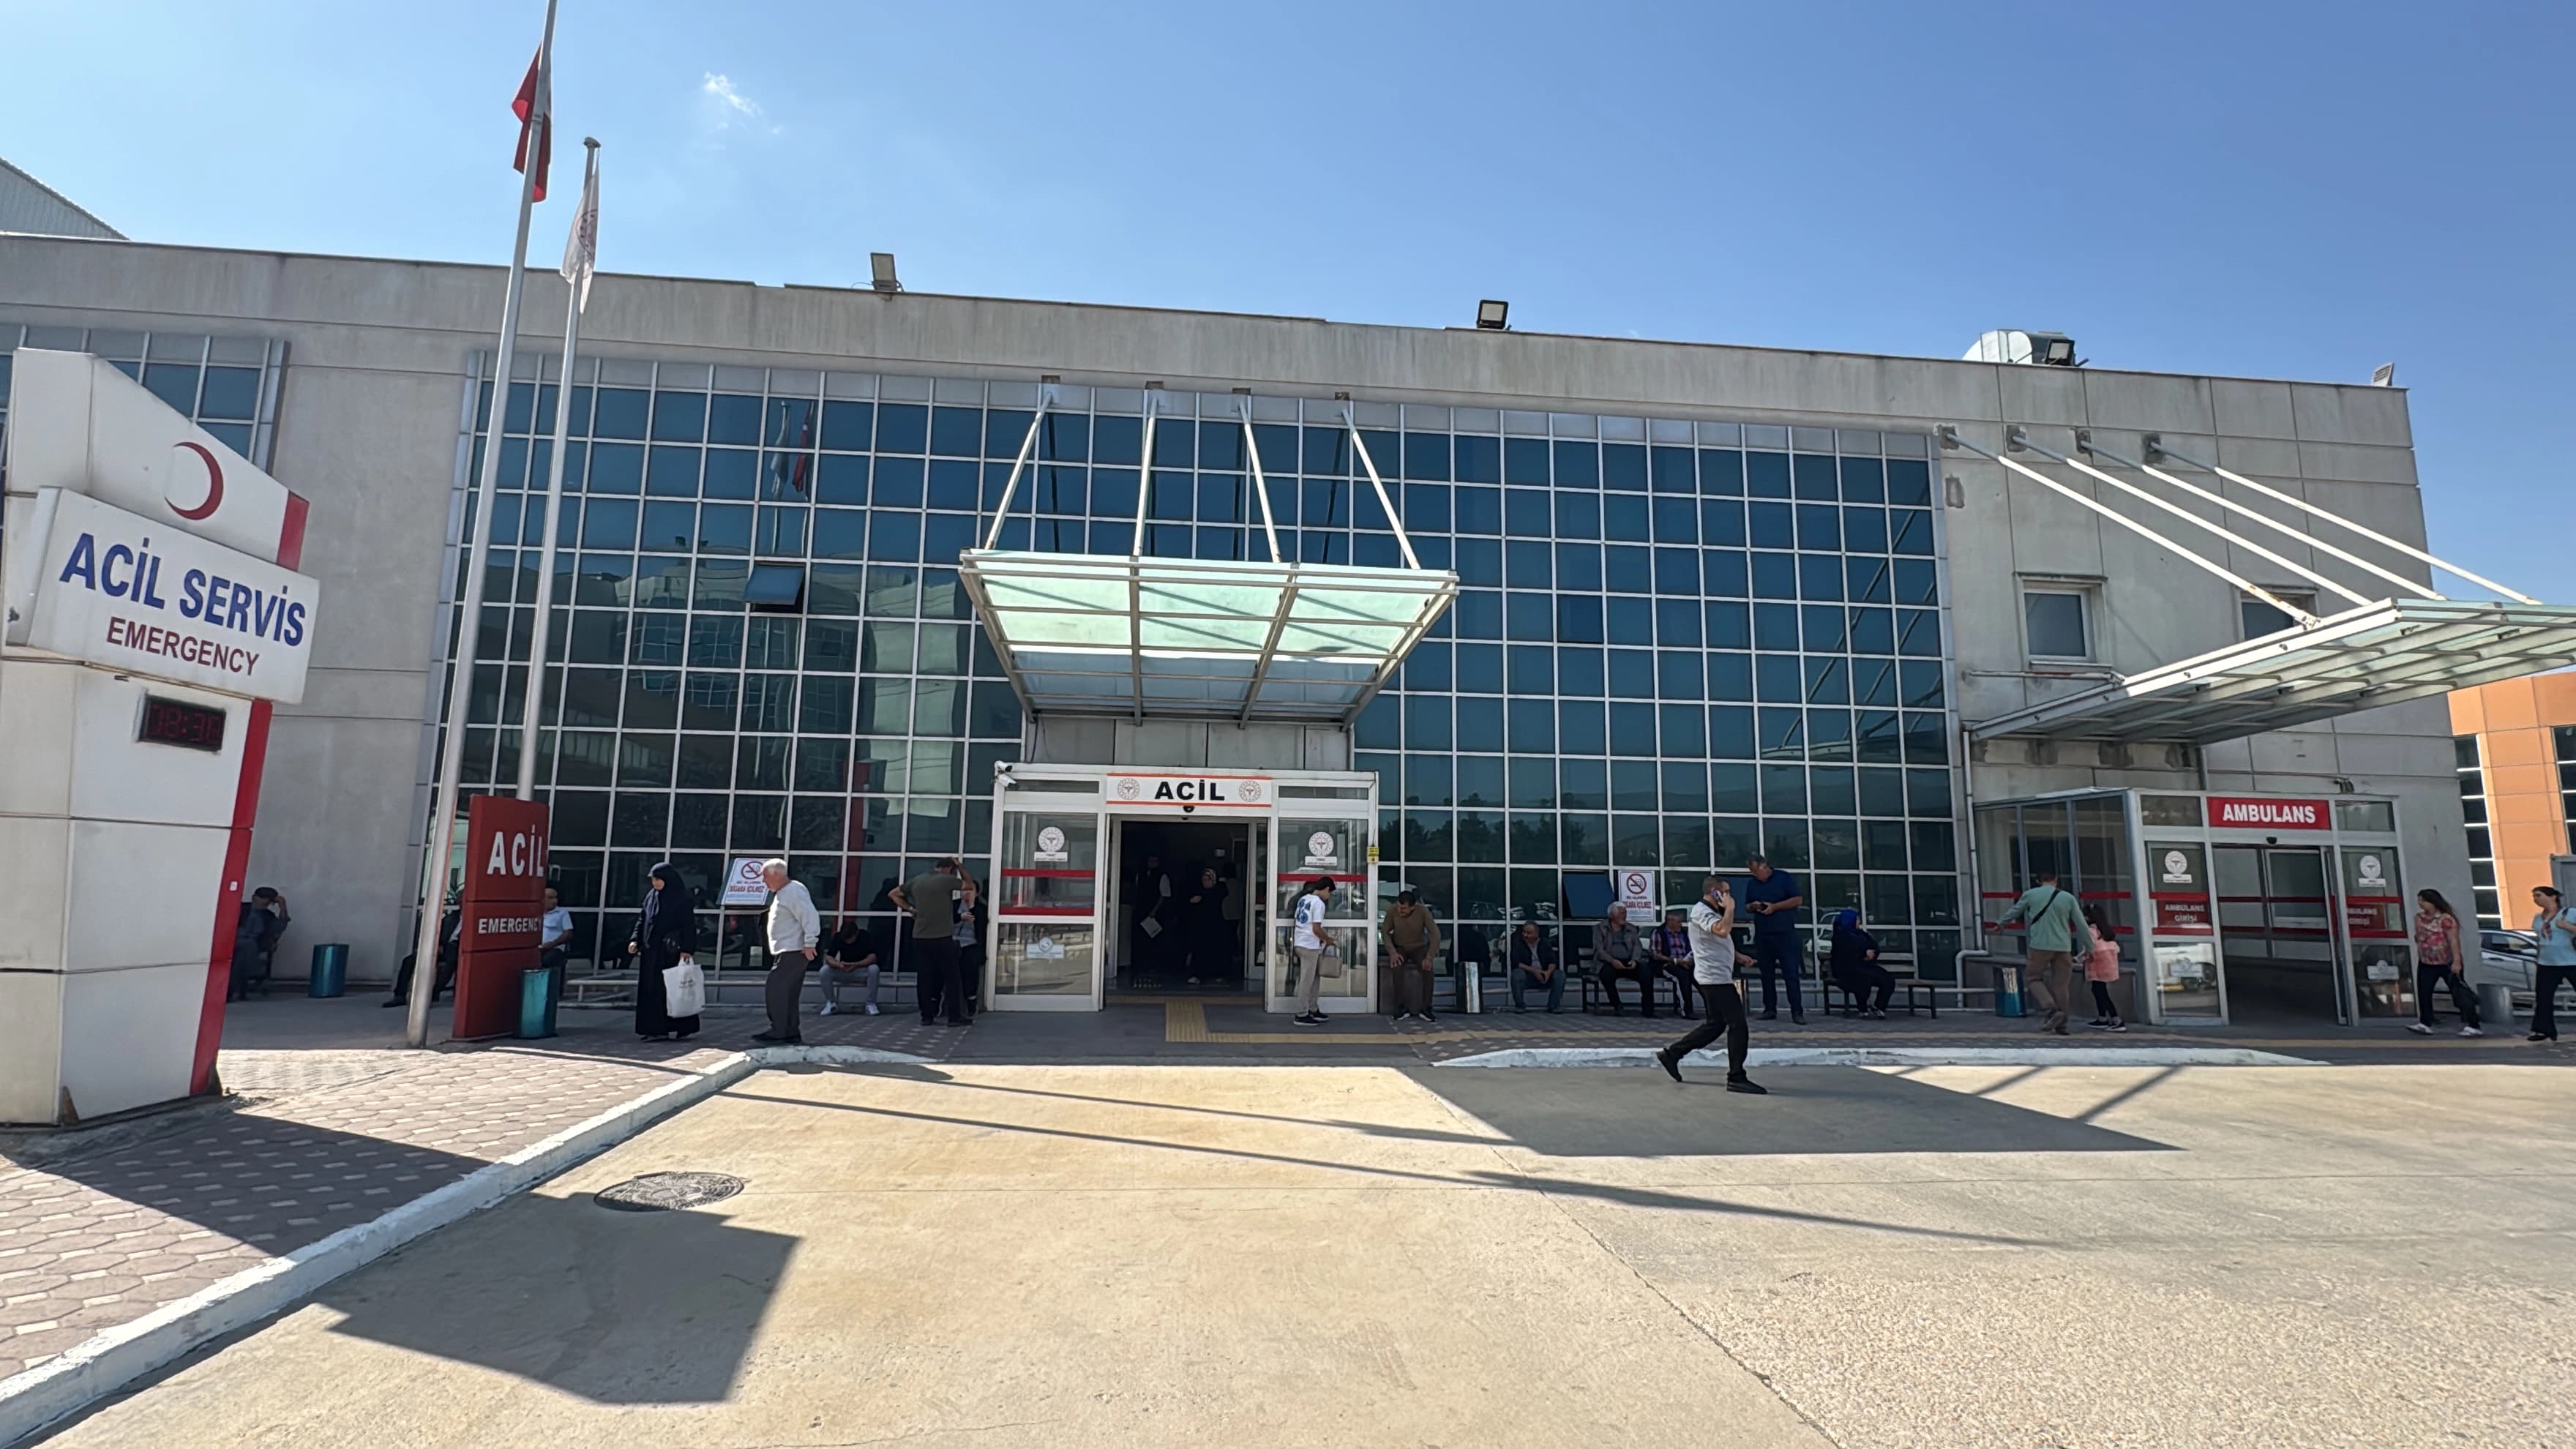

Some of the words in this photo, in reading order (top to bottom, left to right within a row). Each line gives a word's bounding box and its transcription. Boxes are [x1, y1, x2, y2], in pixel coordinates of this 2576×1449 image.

[59, 533, 165, 610] ACİL
[179, 569, 306, 646] SERVİS
[107, 616, 260, 675] EMERGENCY
[1154, 779, 1225, 801] ACİL
[2223, 804, 2316, 823] AMBULANS
[487, 824, 544, 877] ACİL
[2165, 904, 2205, 912] AMBULANS
[478, 918, 542, 934] EMERGENCY
